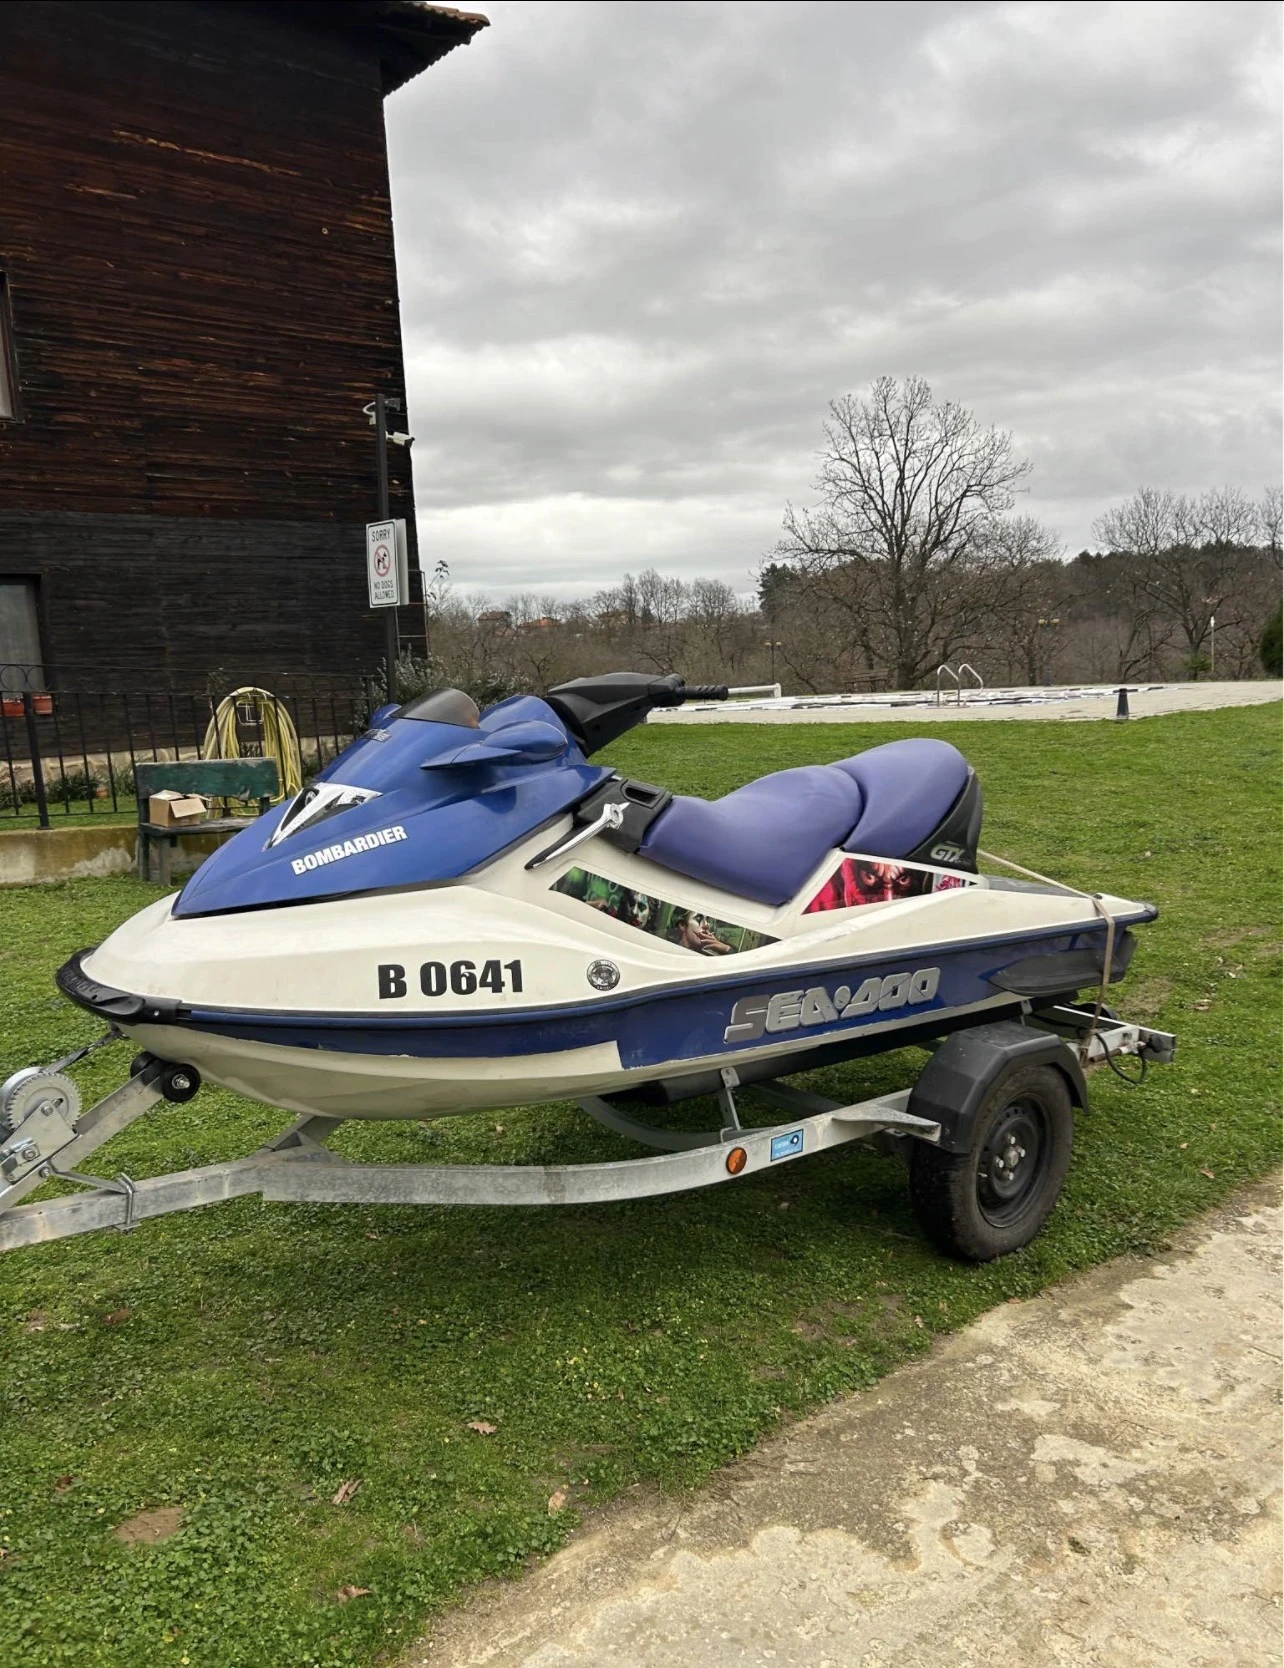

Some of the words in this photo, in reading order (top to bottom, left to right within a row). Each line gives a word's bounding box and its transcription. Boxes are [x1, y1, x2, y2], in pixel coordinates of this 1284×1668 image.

[372, 528, 390, 542] SORRY
[374, 582, 380, 590] NO
[381, 580, 394, 589] DOGS
[375, 590, 394, 600] ALLOWED
[291, 825, 408, 875] BOMBARDIER
[930, 844, 966, 863] GTX
[378, 964, 407, 1000] B
[420, 959, 523, 997] 0641
